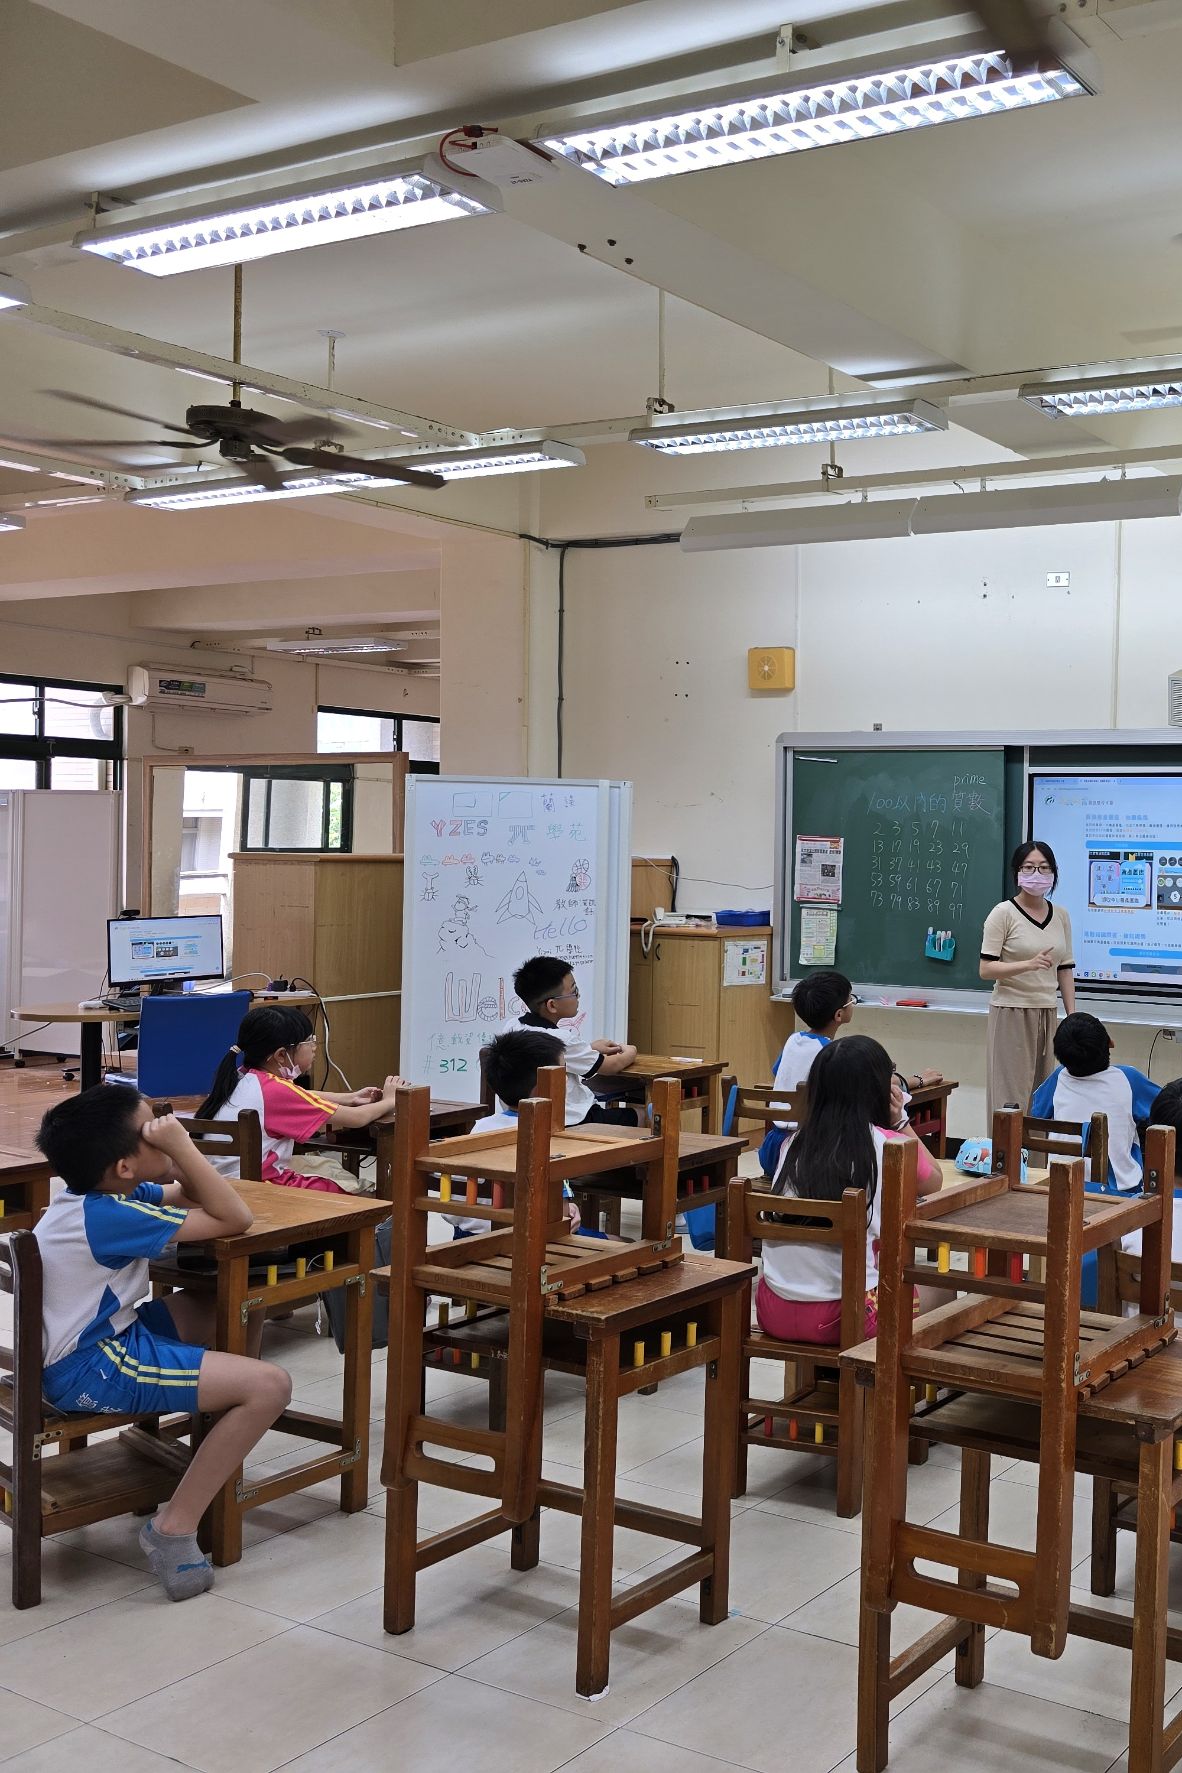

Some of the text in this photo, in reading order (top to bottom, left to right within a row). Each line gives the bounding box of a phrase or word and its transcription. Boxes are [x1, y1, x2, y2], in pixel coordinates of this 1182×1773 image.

[953, 773, 987, 793] prime
[430, 819, 489, 838] YZES
[873, 820, 963, 838] 2 3 5 7 11
[873, 839, 969, 859] 13 17 19 23 29
[872, 856, 968, 878] 31 37 41 43 47
[871, 872, 963, 899] 53 59 61 67 71
[870, 890, 963, 920] 73 79 83 89 97
[533, 913, 588, 940] Hello
[439, 1058, 468, 1074] 312
